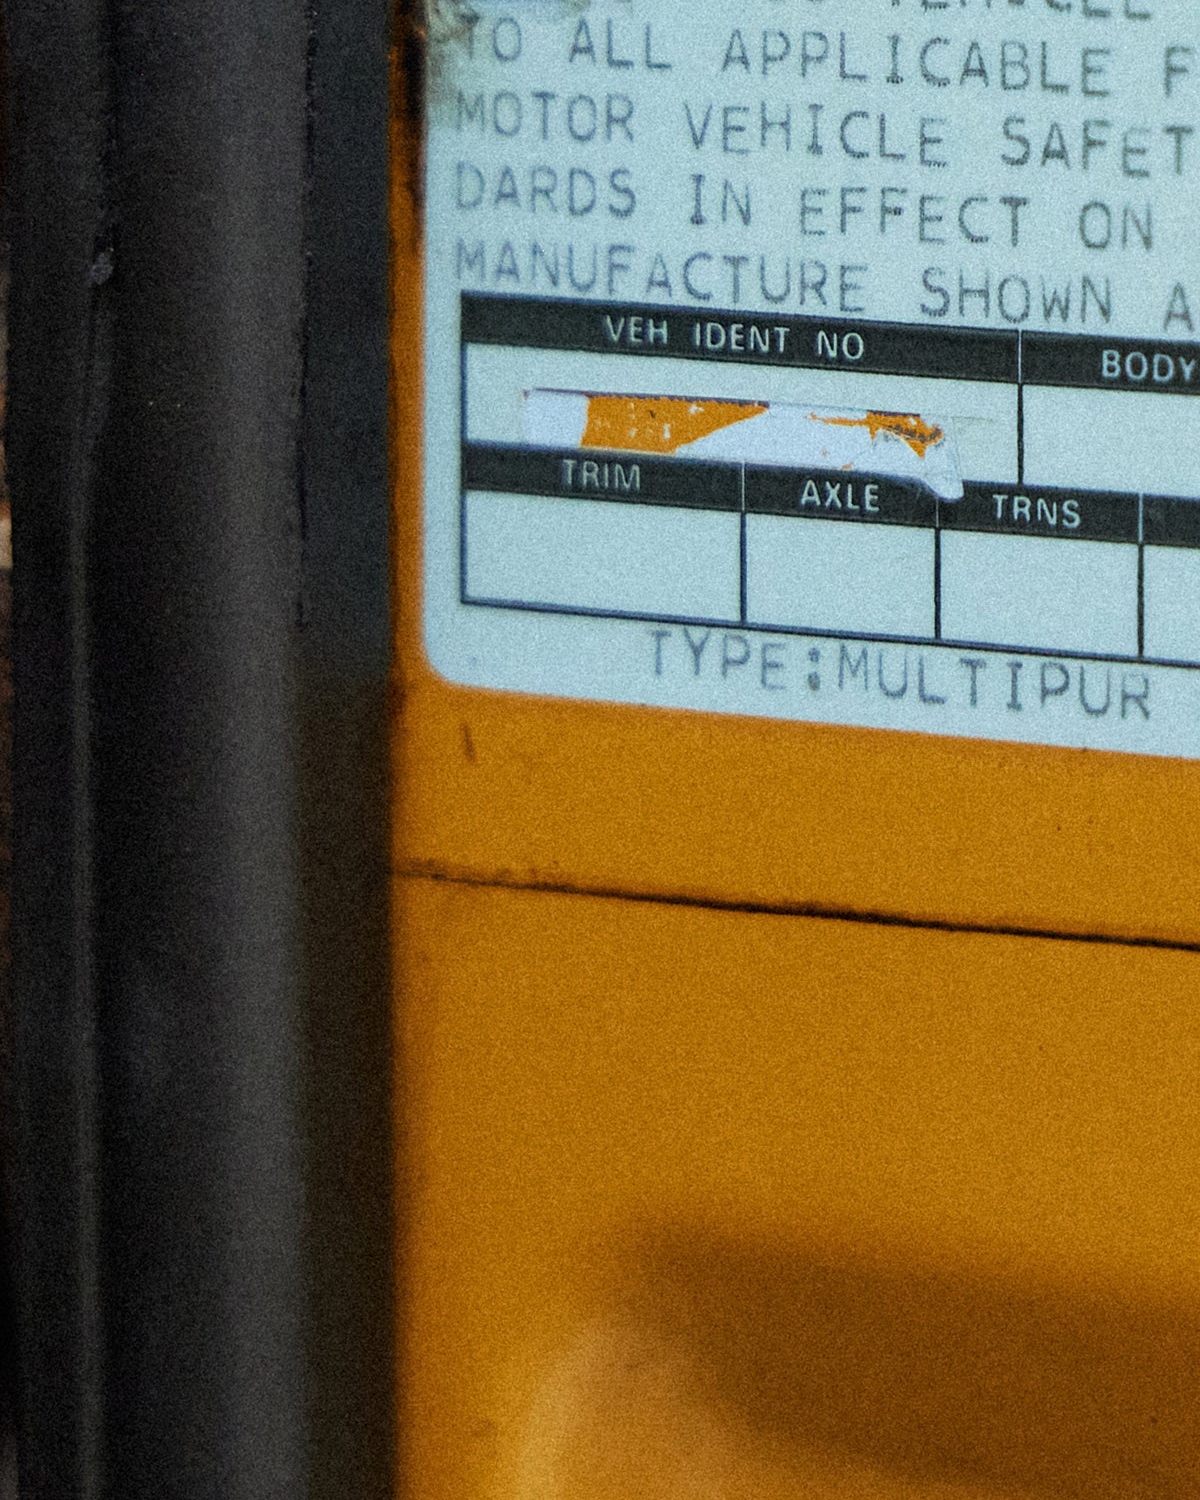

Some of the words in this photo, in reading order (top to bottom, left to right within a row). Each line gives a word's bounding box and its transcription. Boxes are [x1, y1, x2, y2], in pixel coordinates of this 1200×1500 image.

[568, 18, 672, 70] ALL
[721, 29, 1112, 98] APPLICABLE
[456, 91, 636, 142] MOTOR
[683, 102, 950, 168] VEHICLE
[456, 160, 638, 218] DARDS
[690, 174, 752, 226] IN
[799, 186, 1027, 248] EFFECT
[1078, 201, 1154, 251] ON
[456, 238, 870, 314] MANUFACTURE
[919, 266, 1113, 326] SHOWN
[603, 315, 669, 347] VEH
[694, 322, 790, 354] IDENT
[816, 331, 865, 361] NO
[1101, 349, 1198, 381] BODY
[561, 458, 642, 491] TRIM
[800, 480, 881, 511] AXLE
[992, 493, 1082, 529] TRNS
